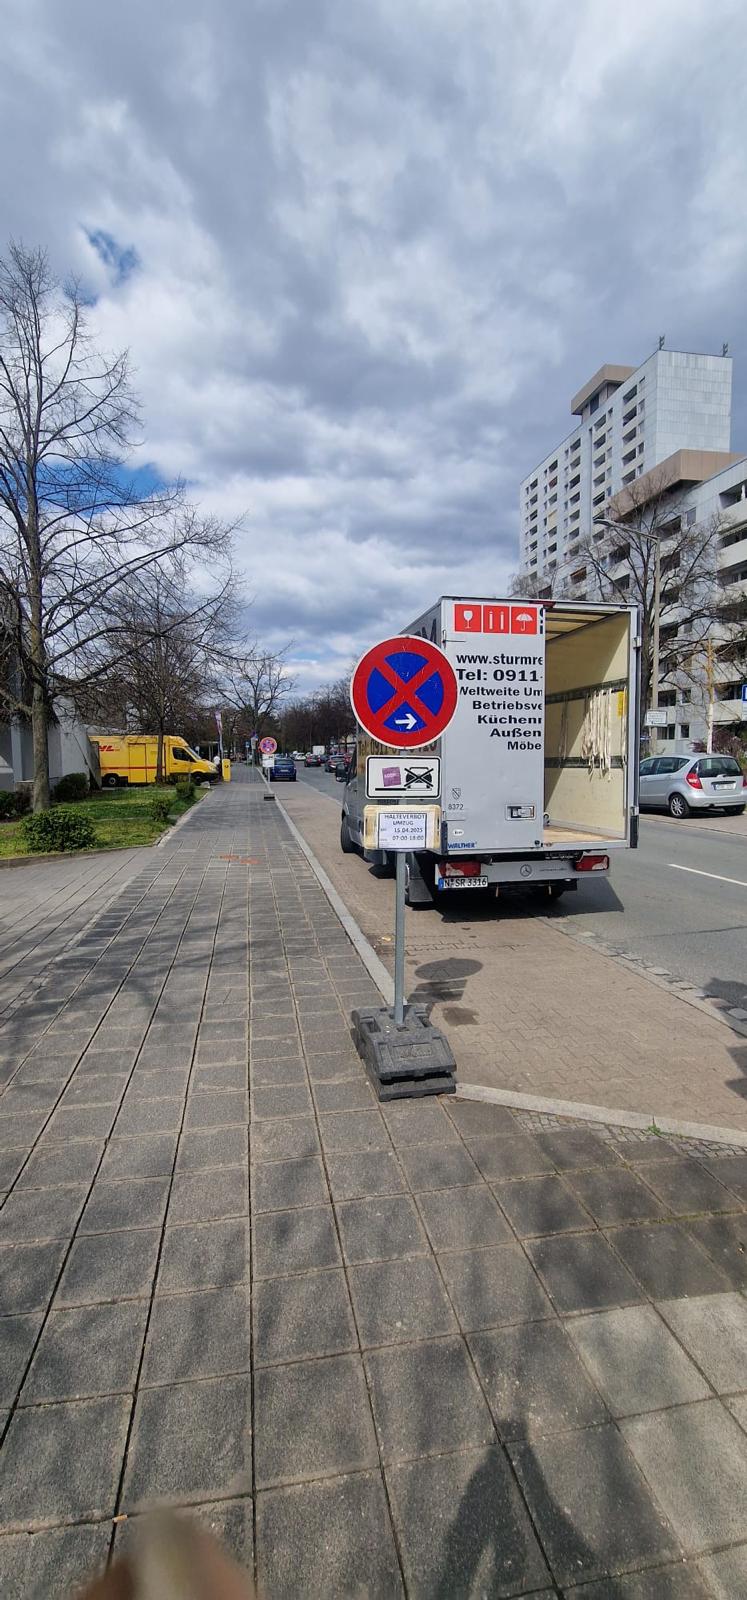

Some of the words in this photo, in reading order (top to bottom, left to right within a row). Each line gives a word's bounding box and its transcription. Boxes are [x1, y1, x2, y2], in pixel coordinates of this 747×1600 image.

[456, 668, 487, 681] Tel:
[489, 727, 542, 738] Außen
[507, 740, 542, 750] Möbe
[448, 803, 464, 811] 8372
[445, 879, 450, 887] N
[455, 878, 466, 887] SR
[467, 877, 487, 887] 3316
